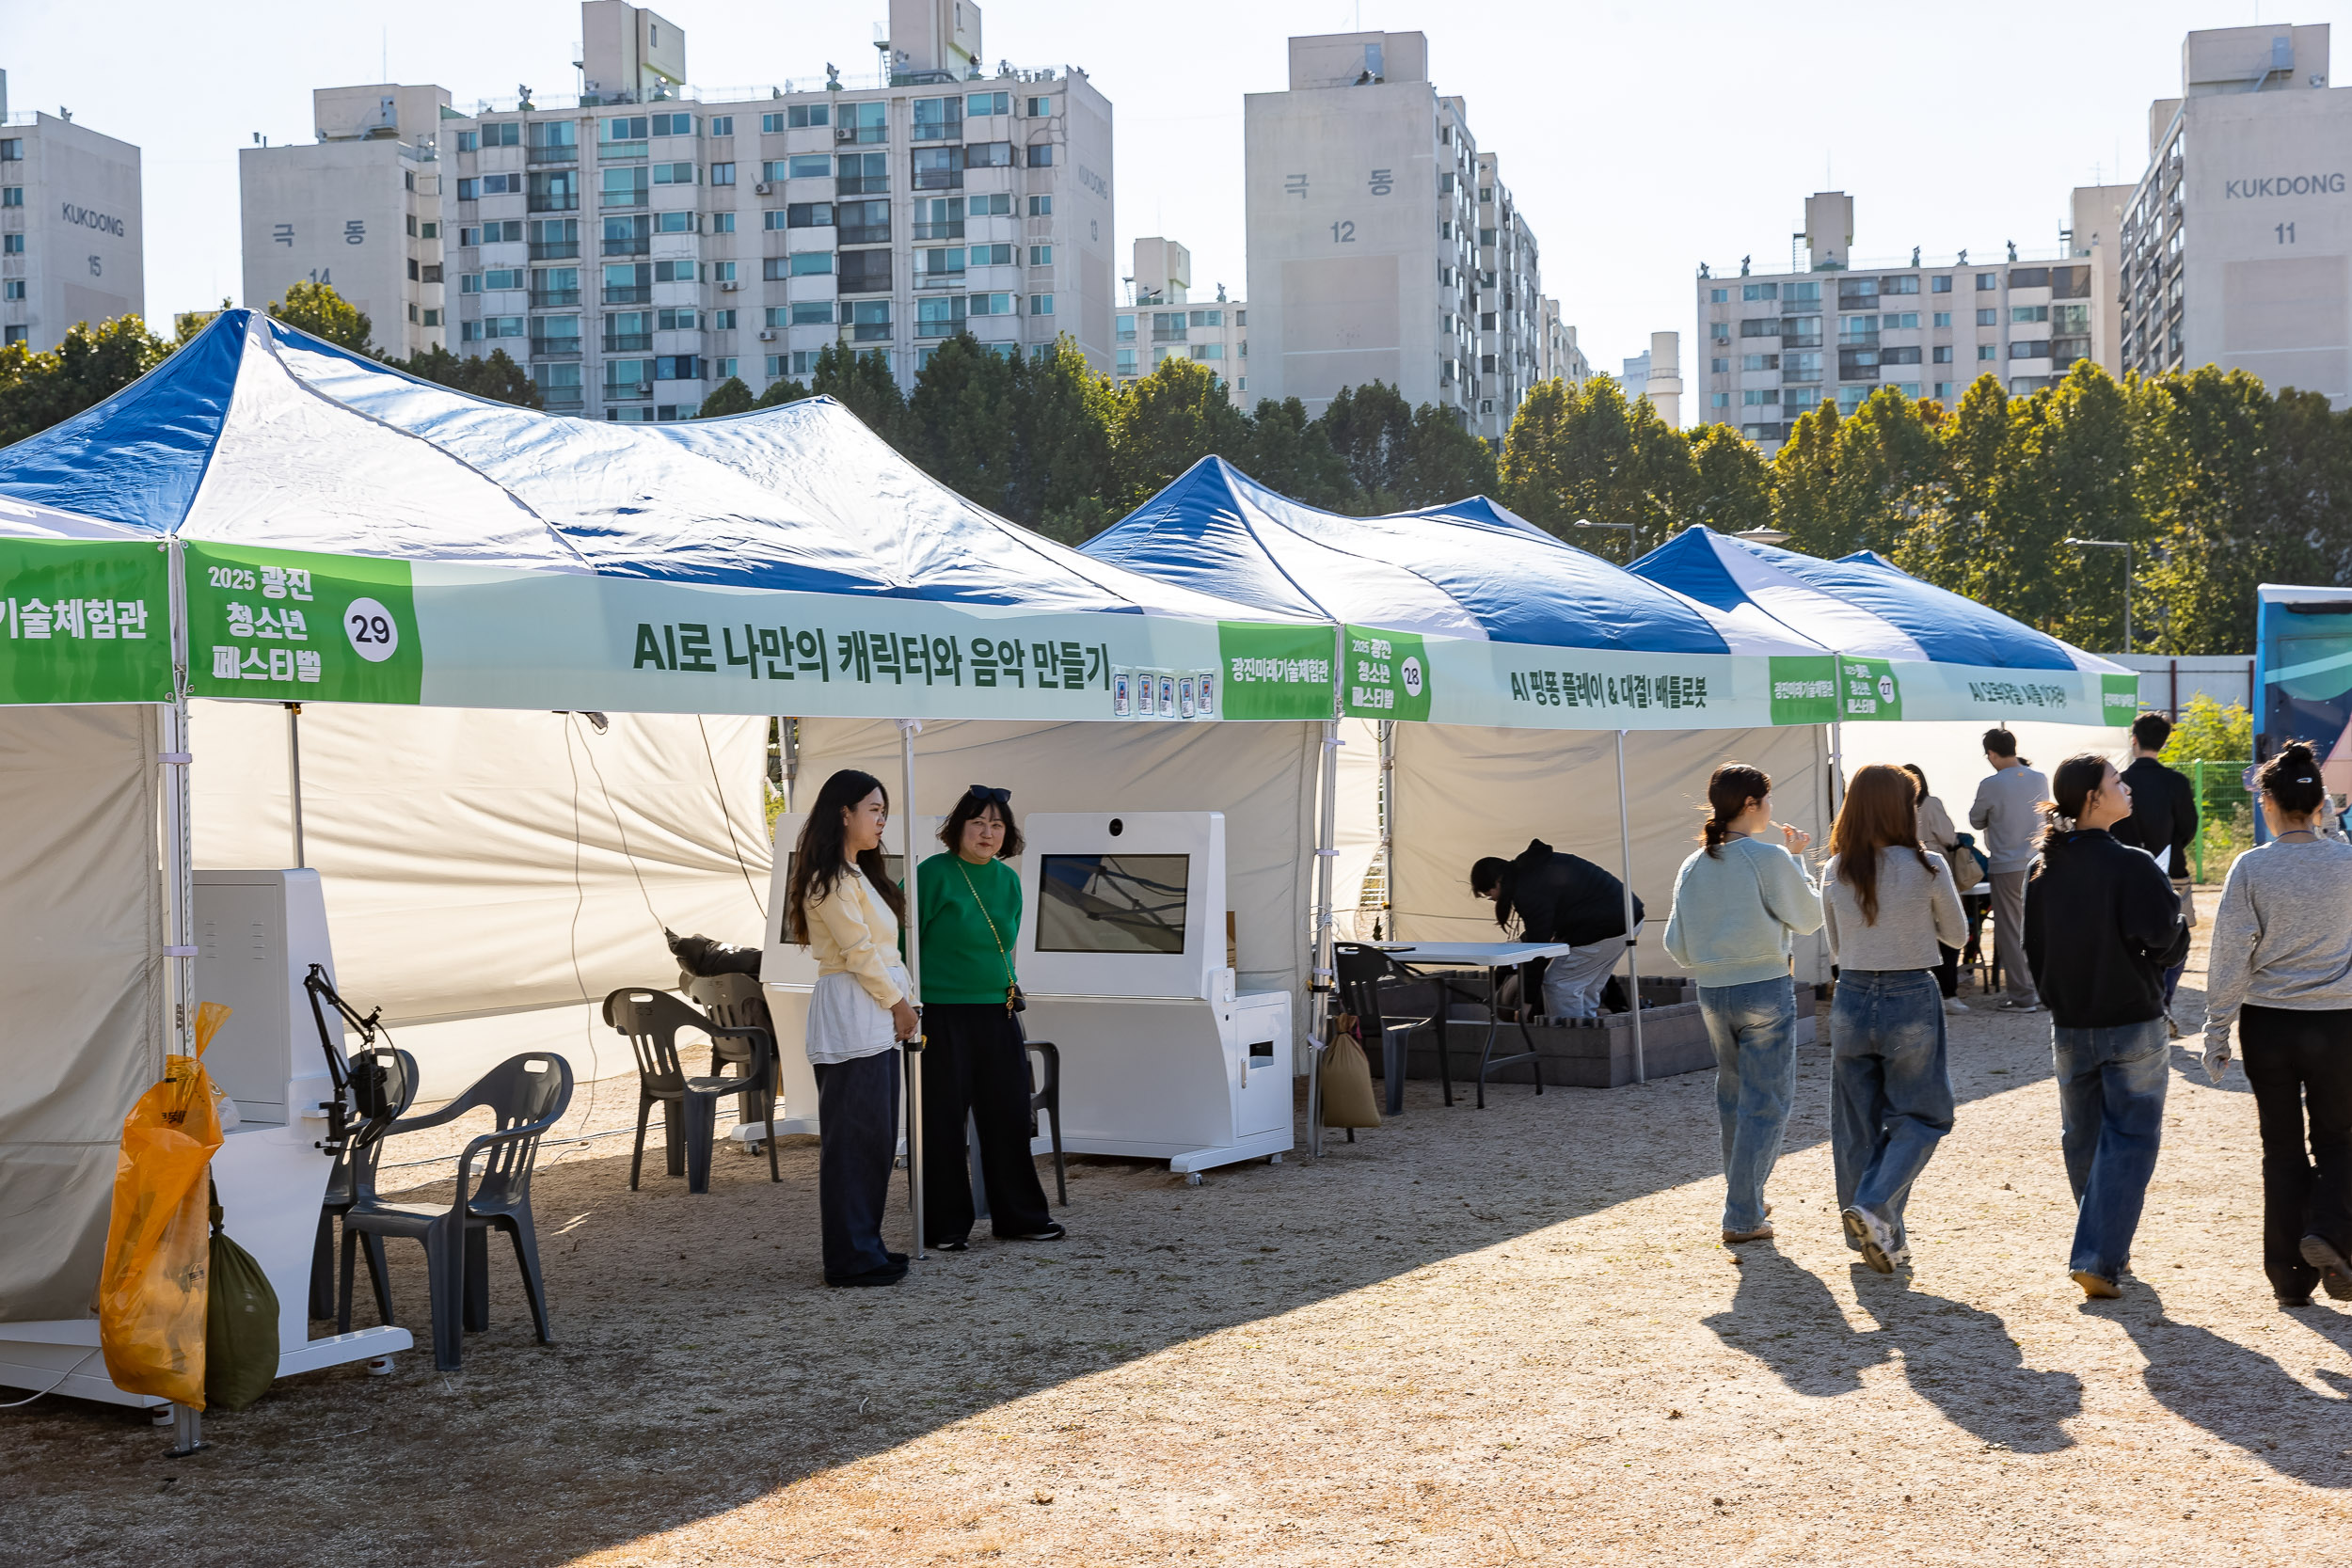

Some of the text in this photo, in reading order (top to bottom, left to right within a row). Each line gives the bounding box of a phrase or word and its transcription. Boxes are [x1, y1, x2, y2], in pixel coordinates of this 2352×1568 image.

[1284, 169, 1394, 198] 극 동
[2226, 173, 2345, 199] KUKDONG
[62, 201, 124, 237] KUKDONG
[1330, 220, 1356, 243] 12
[272, 220, 366, 247] 극 동
[2274, 222, 2296, 245] 11
[87, 255, 102, 277] 15
[310, 268, 331, 285] 14
[207, 565, 314, 601] 2025 광진
[226, 602, 309, 641] 청소년
[351, 613, 390, 645] 29
[633, 623, 1110, 691] AI로 나만의 캐릭터와 음악 만들기
[1371, 638, 1392, 659] 광진
[212, 644, 322, 683] 페스티벌
[1231, 657, 1328, 683] 광진미래기술체험관
[1358, 660, 1391, 684] 청소년
[1404, 667, 1420, 686] 28
[1351, 687, 1394, 709] 페스티벌
[1510, 670, 1708, 709] AI 핑퐁 플레이 & 대결! 배틀로봇
